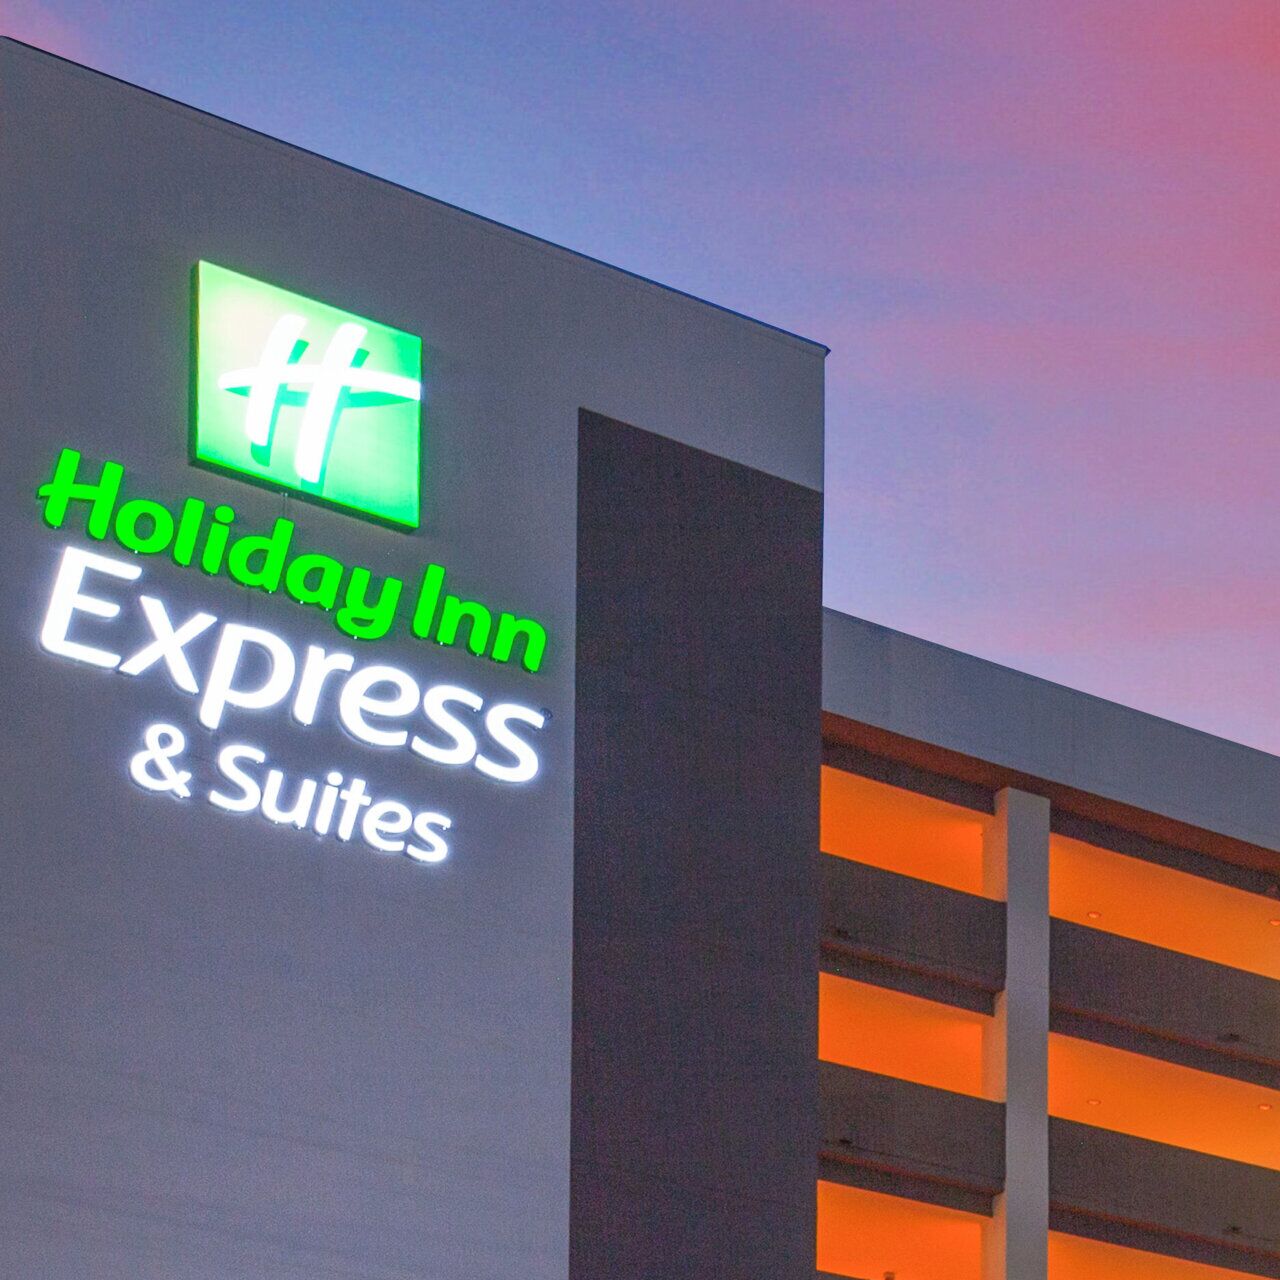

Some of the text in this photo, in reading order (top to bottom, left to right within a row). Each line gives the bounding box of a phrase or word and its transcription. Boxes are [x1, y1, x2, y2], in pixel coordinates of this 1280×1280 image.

[36, 447, 548, 673] Holiday Inn
[38, 545, 545, 784] Express
[129, 722, 452, 863] & Suites
